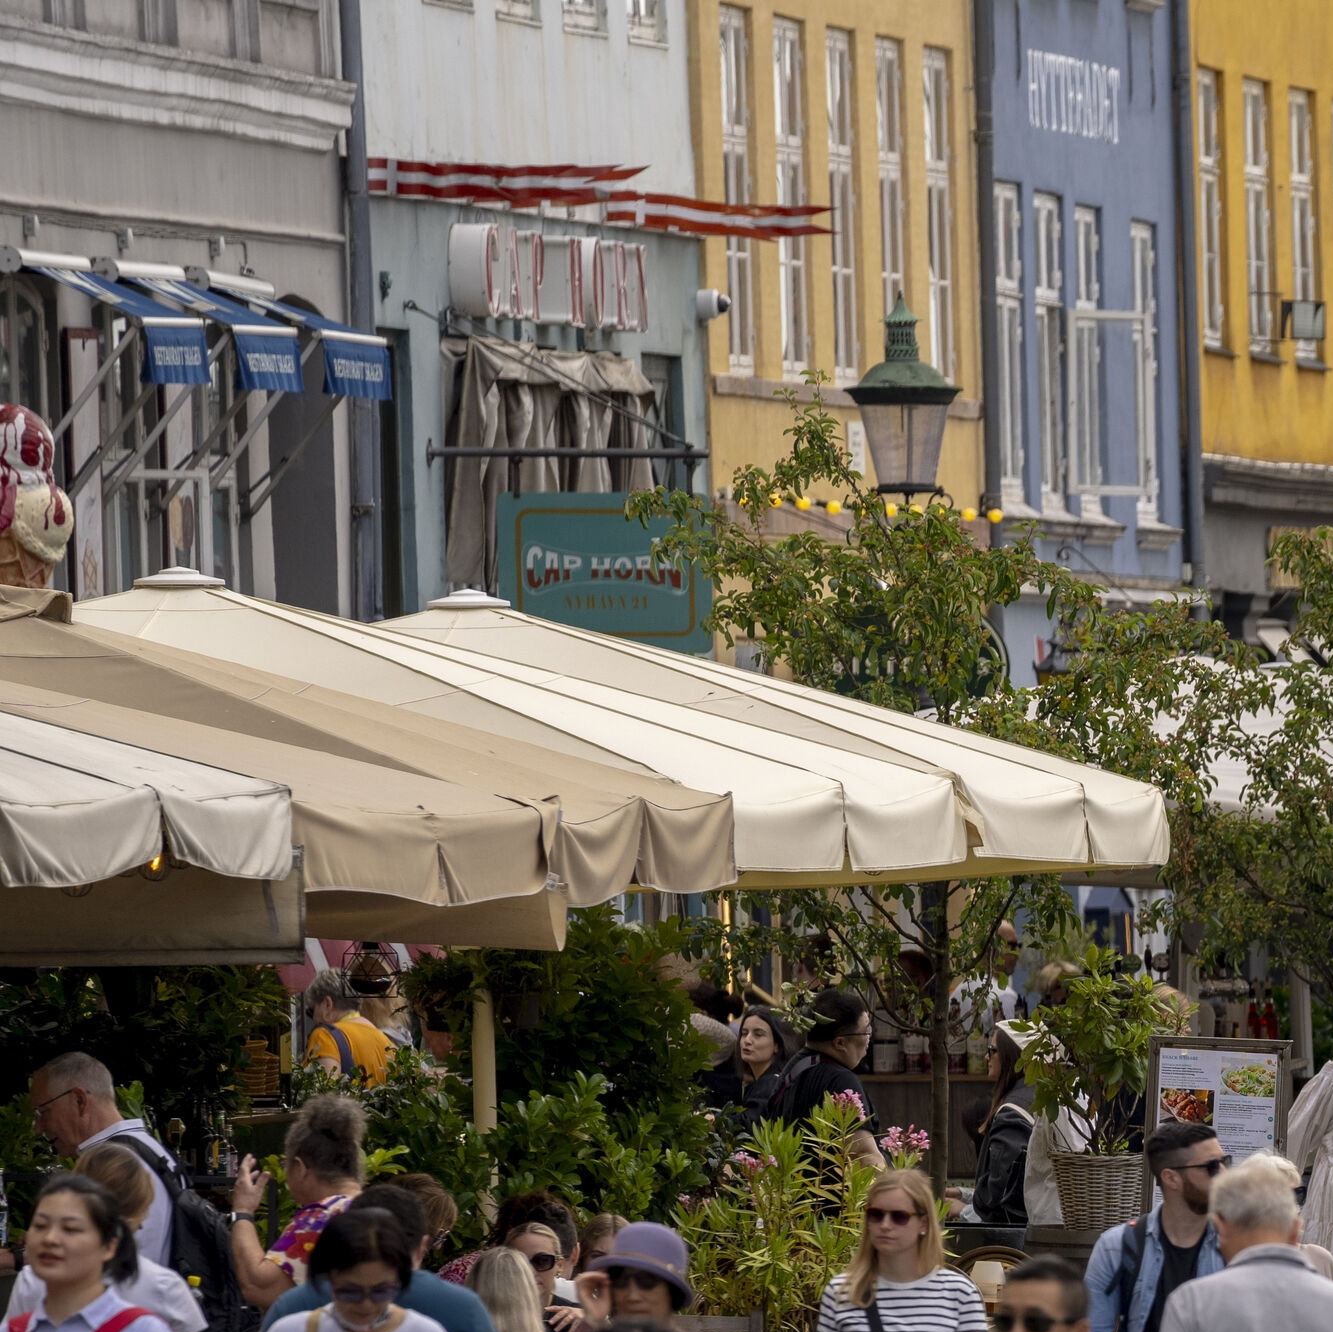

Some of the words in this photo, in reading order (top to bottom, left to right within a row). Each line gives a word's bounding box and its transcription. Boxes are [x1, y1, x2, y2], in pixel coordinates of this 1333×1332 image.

[486, 223, 545, 324] CAP
[569, 235, 648, 333] HORN
[526, 545, 582, 589] CAP
[591, 537, 682, 589] HORN
